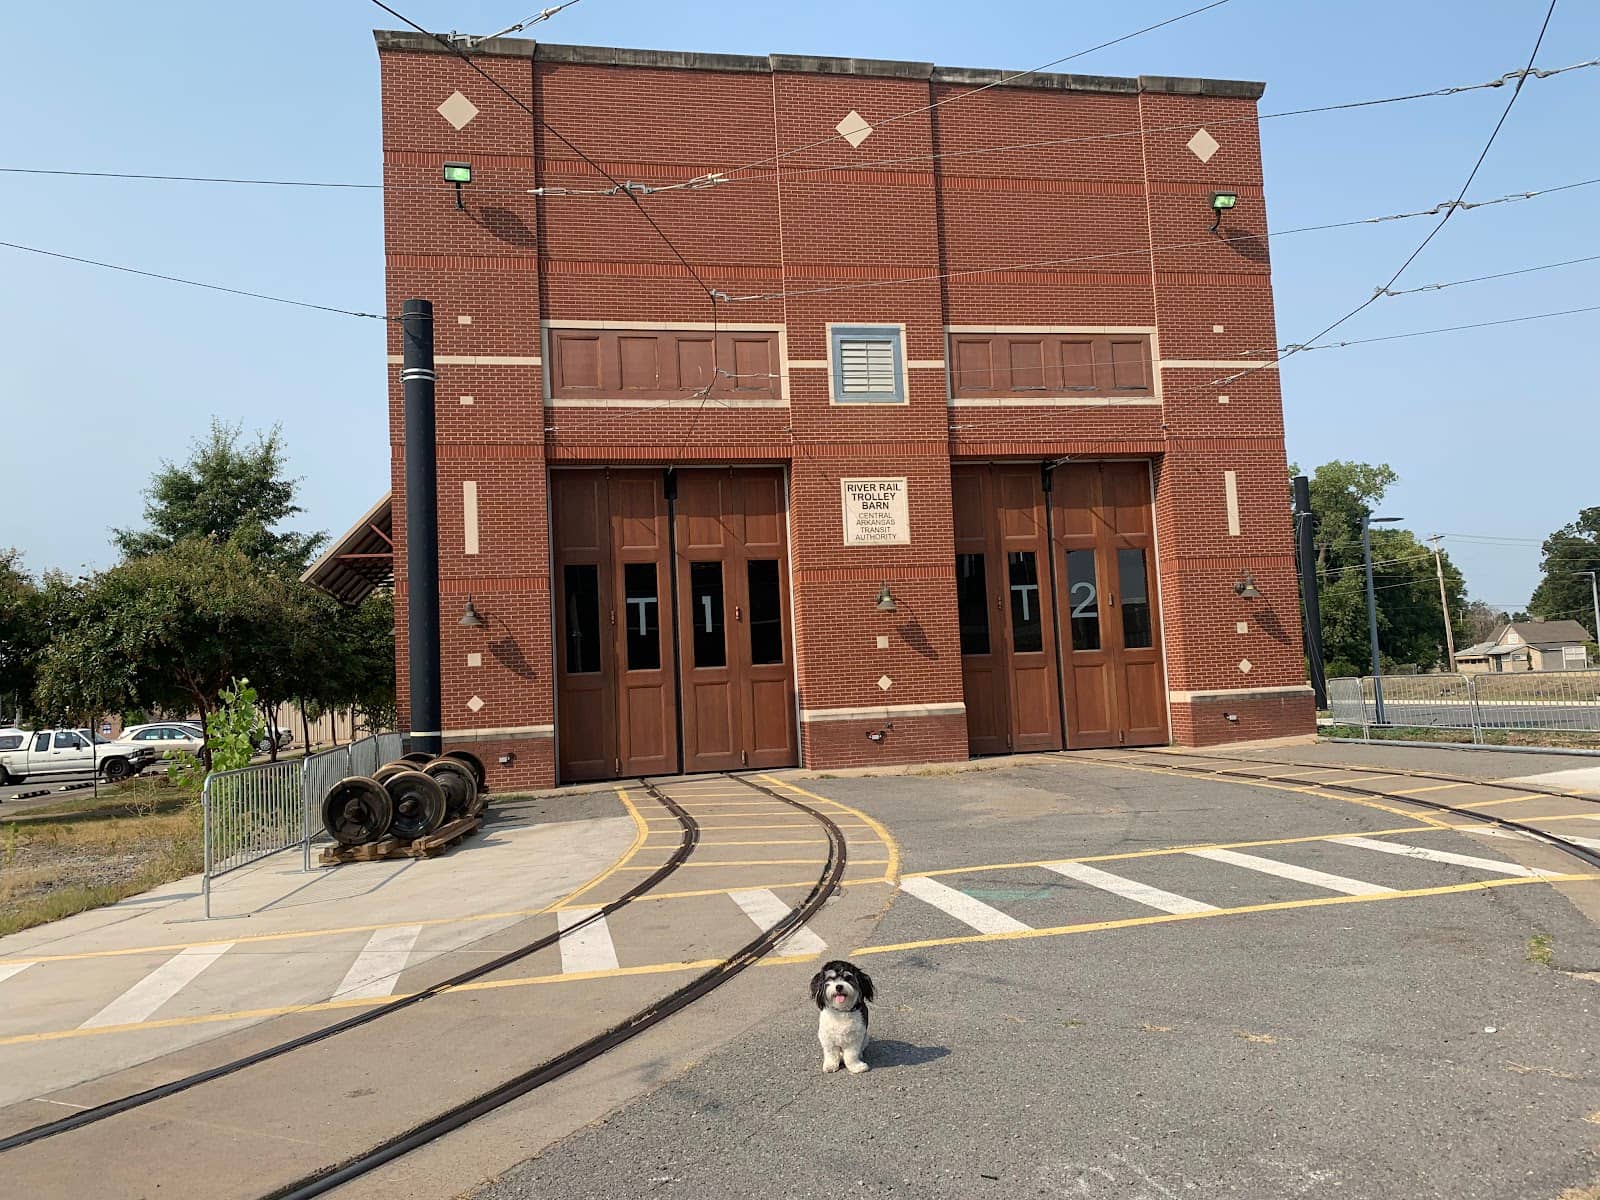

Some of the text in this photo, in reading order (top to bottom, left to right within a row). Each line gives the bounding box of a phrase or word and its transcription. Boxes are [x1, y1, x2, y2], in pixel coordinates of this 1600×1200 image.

[847, 483, 902, 492] RIVER RAIL
[851, 492, 896, 501] TROLLEY
[862, 501, 889, 510] BARN
[855, 533, 897, 541] AUTHORITY
